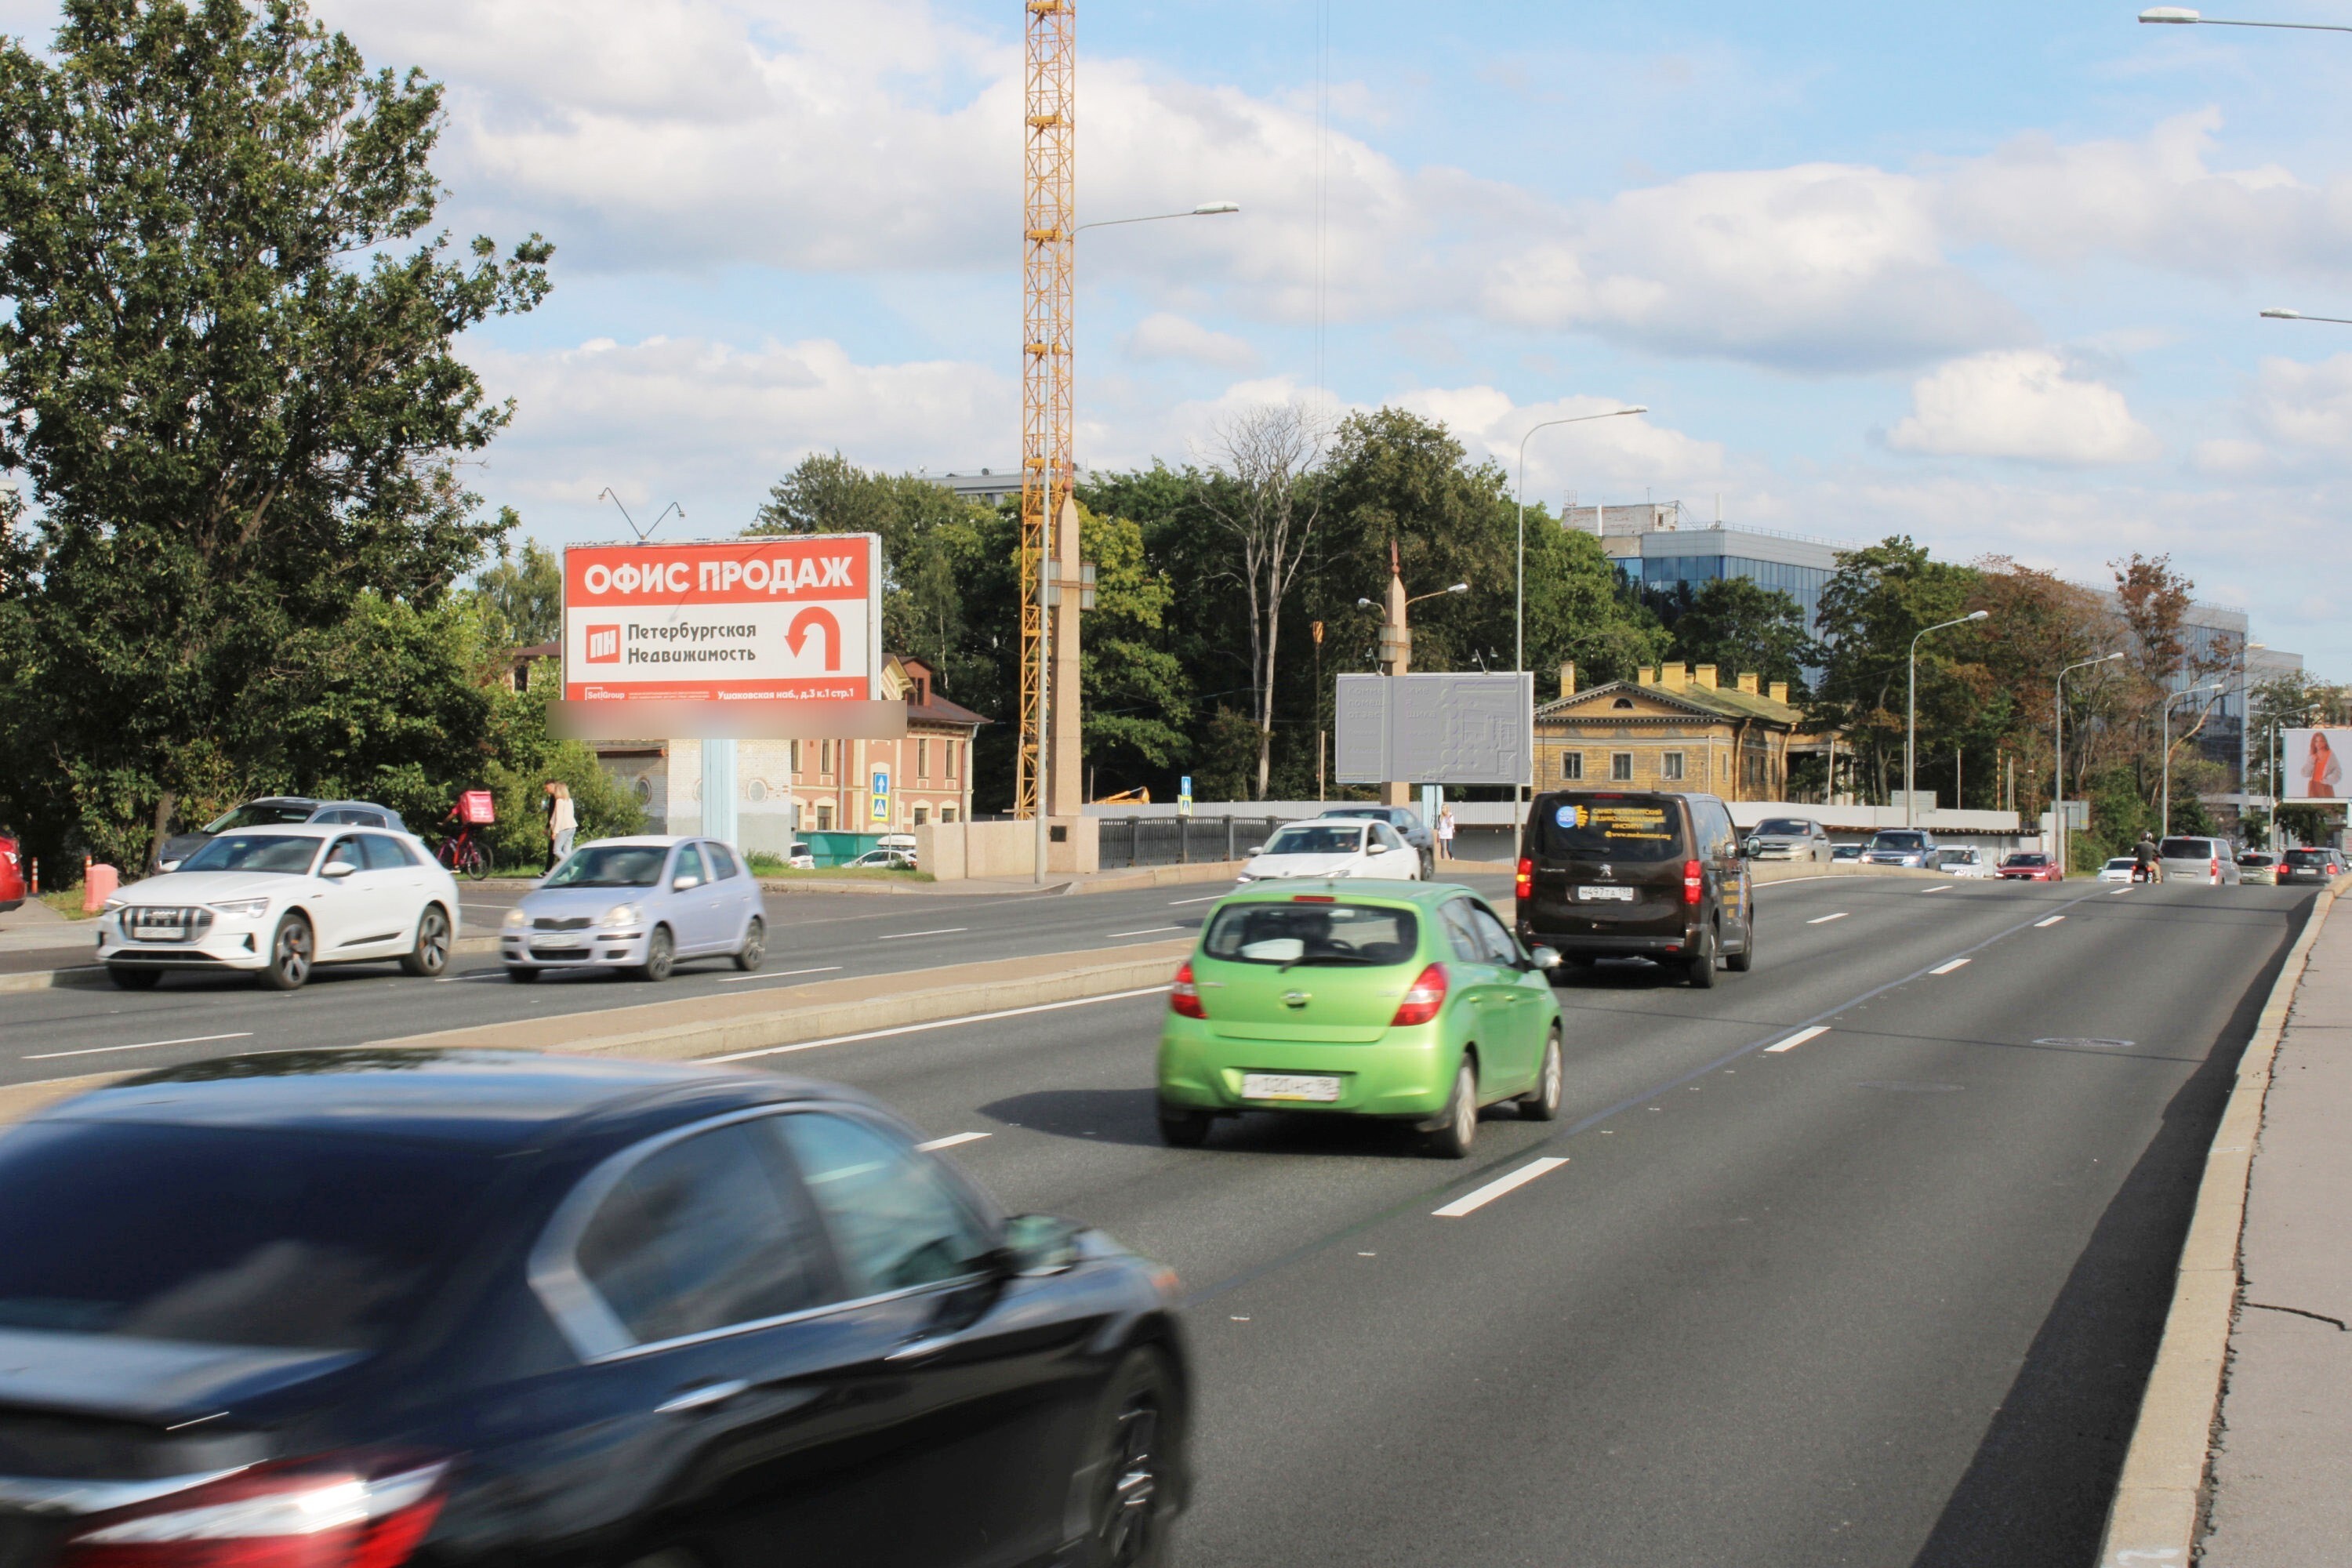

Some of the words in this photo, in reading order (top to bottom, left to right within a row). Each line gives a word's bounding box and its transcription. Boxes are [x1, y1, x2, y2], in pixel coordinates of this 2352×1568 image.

[585, 562, 691, 594] ОФИС
[699, 556, 854, 594] ПРОДАЖ
[628, 622, 757, 642] Петербургская
[628, 647, 756, 665] Недвижимость
[717, 691, 774, 700] Ушаковская
[831, 688, 855, 699] стр.1
